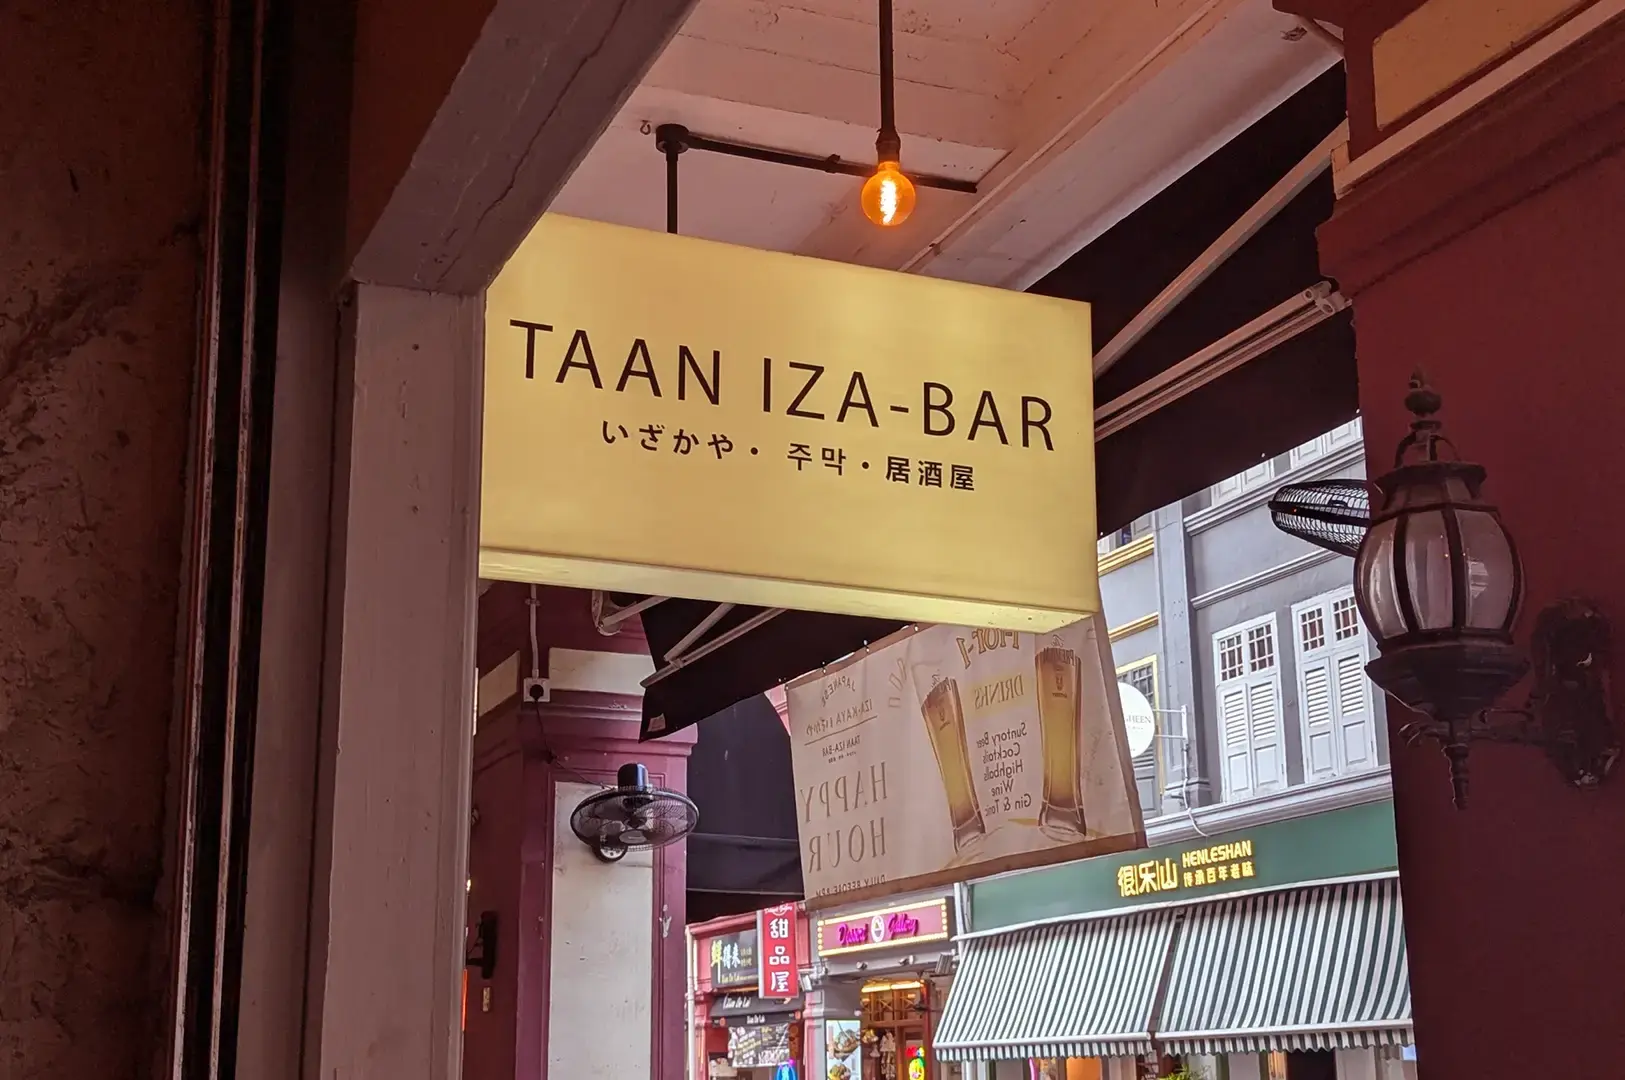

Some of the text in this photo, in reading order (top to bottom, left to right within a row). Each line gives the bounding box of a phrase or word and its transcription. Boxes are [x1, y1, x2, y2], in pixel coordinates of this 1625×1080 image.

[509, 319, 1055, 451] TAAN IZA-BAR
[1117, 857, 1178, 897] 很乐山
[1182, 840, 1252, 868] HENLESHAN
[769, 918, 790, 992] 甜品屋
